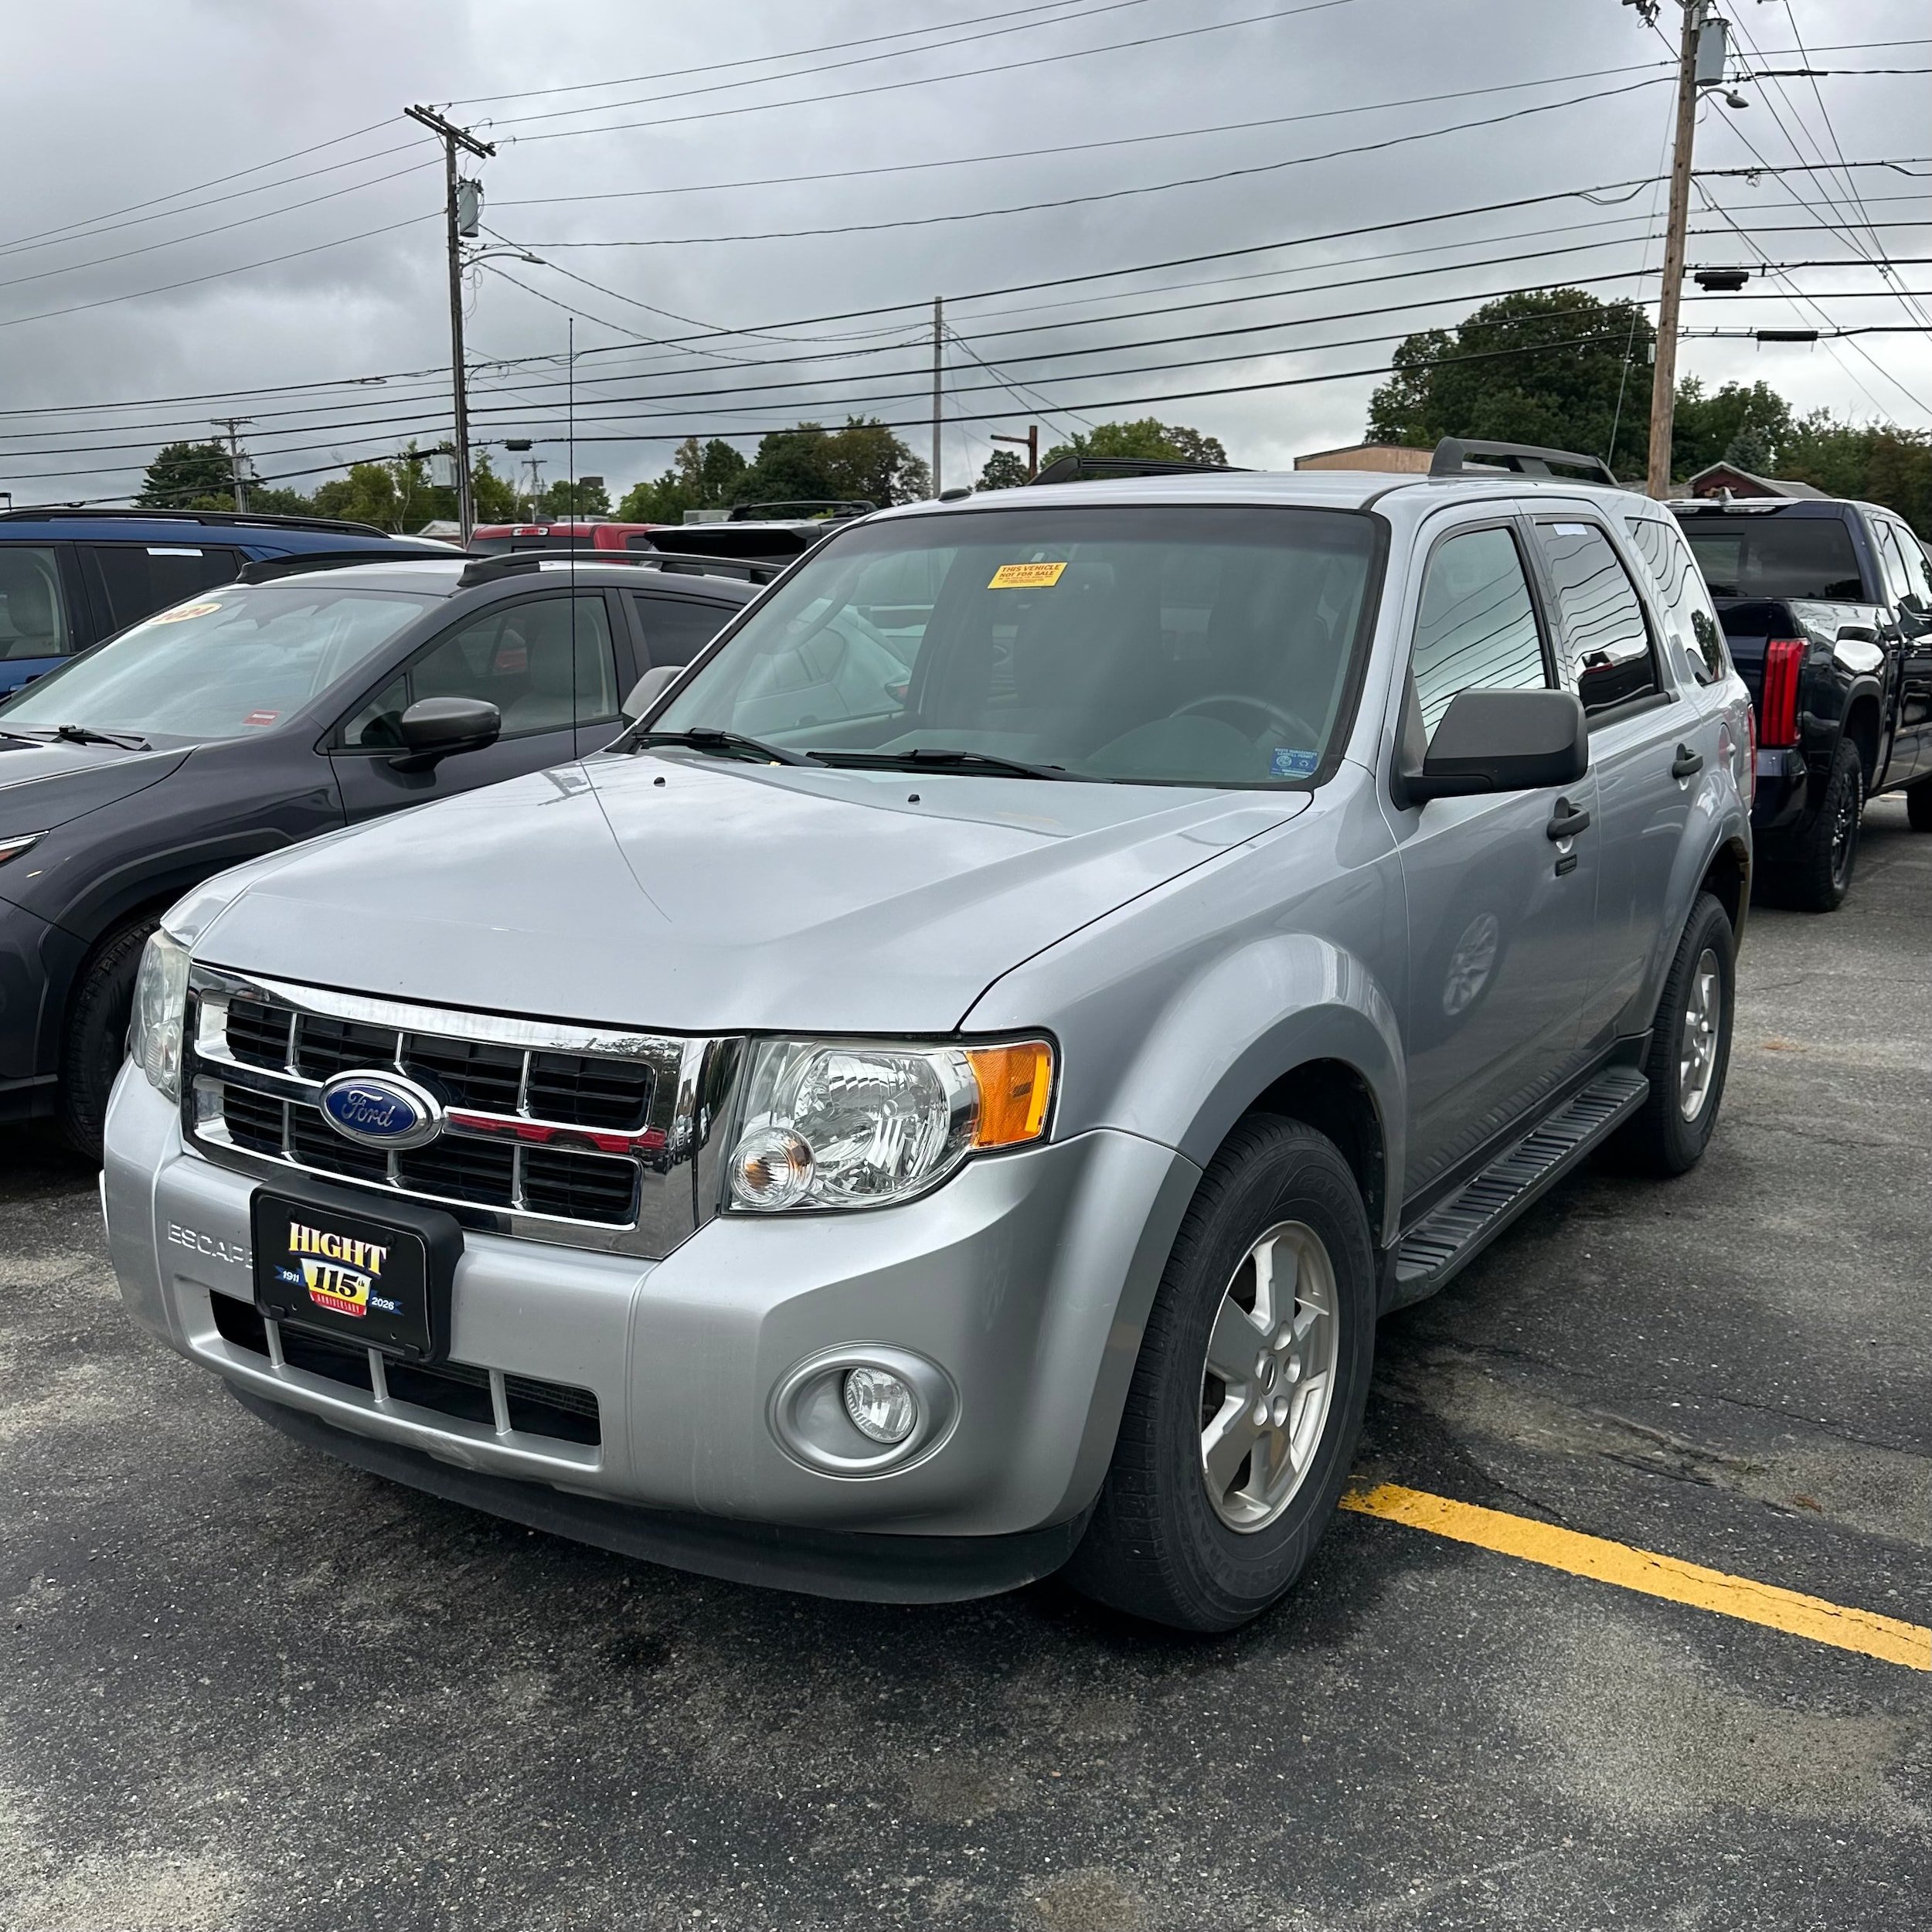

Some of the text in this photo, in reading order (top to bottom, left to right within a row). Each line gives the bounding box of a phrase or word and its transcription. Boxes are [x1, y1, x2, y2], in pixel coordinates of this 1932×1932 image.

[342, 1090, 396, 1128] Ford
[288, 1222, 387, 1275] HIGHT
[283, 1270, 300, 1283] 1911
[316, 1294, 360, 1314] ANNIVERSARY
[371, 1297, 395, 1311] 2026
